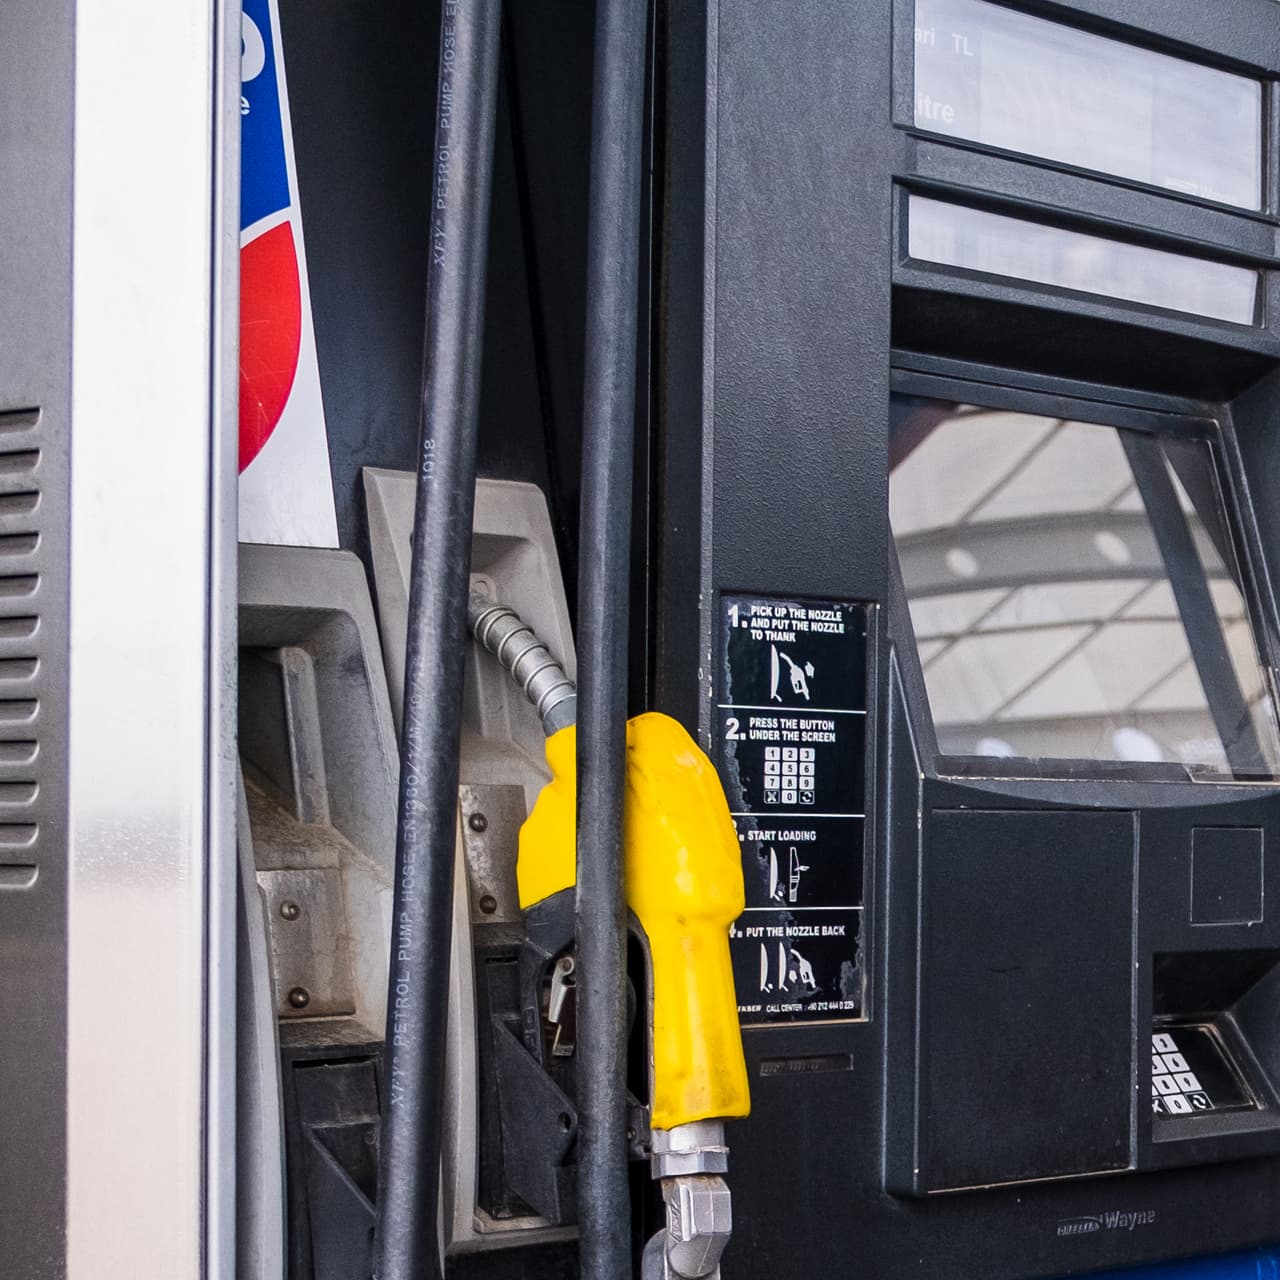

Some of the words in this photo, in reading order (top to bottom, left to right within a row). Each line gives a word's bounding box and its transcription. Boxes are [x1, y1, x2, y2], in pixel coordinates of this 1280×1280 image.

[443, 25, 457, 73] HOSE
[951, 32, 974, 56] TL
[440, 82, 454, 129] PUMP
[436, 138, 451, 209] PETROL
[750, 606, 772, 617] PICK
[774, 607, 787, 618] UP
[789, 608, 806, 619] THE
[808, 609, 842, 622] NOZZLE
[751, 618, 769, 629] AND
[772, 619, 789, 630] PUT
[791, 620, 808, 631] THE
[811, 622, 845, 634] NOZZLE
[751, 630, 764, 641] TO
[765, 631, 796, 643] THANK
[725, 718, 746, 741] 2.
[749, 717, 778, 729] PRESS
[780, 718, 797, 729] THE
[799, 719, 835, 730] BUTTON
[749, 730, 780, 741] UNDER
[782, 731, 800, 742] THE
[802, 731, 836, 743] SCREEN
[747, 831, 776, 841] START
[778, 831, 817, 841] LOADING
[401, 852, 417, 902] HOSE
[397, 911, 414, 961] PUMP
[746, 927, 764, 937] PUT
[767, 927, 784, 937] THE
[786, 926, 820, 937] NOZZLE
[821, 925, 846, 937] BACK
[392, 971, 411, 1047] PETROL
[766, 1004, 780, 1013] CALL
[781, 1003, 803, 1012] CENTER
[1105, 1210, 1155, 1231] Wayne
